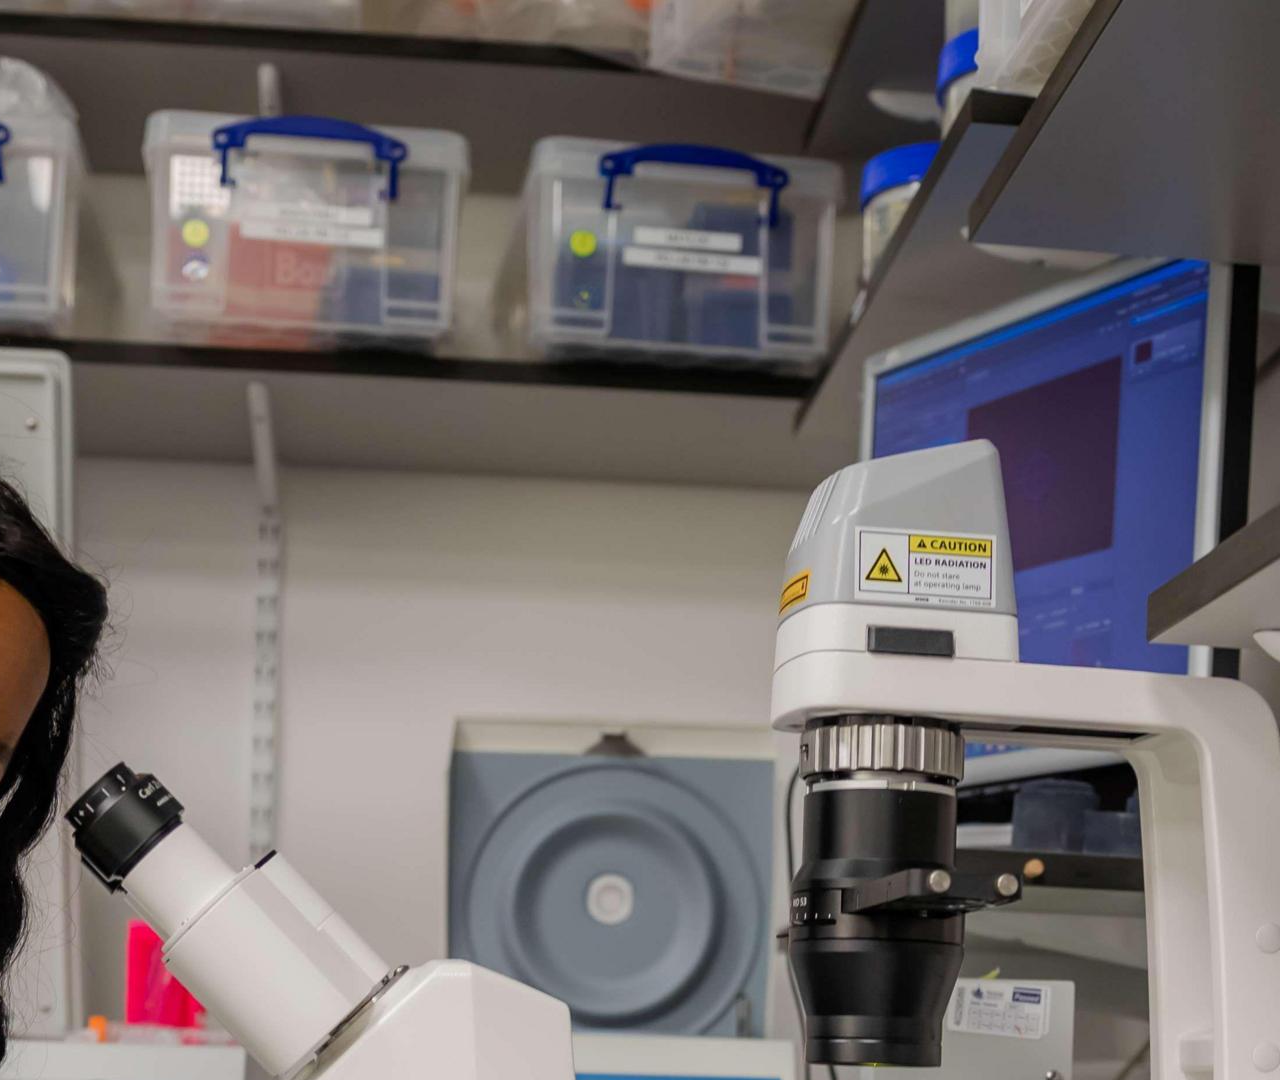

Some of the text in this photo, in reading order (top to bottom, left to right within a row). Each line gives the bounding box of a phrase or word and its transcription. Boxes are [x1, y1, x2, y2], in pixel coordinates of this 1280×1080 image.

[930, 539, 987, 553] CAUTION
[914, 557, 987, 569] LED RADIATION
[913, 570, 960, 580] Do not stare
[923, 580, 961, 591] operating
[962, 581, 981, 592] lamp
